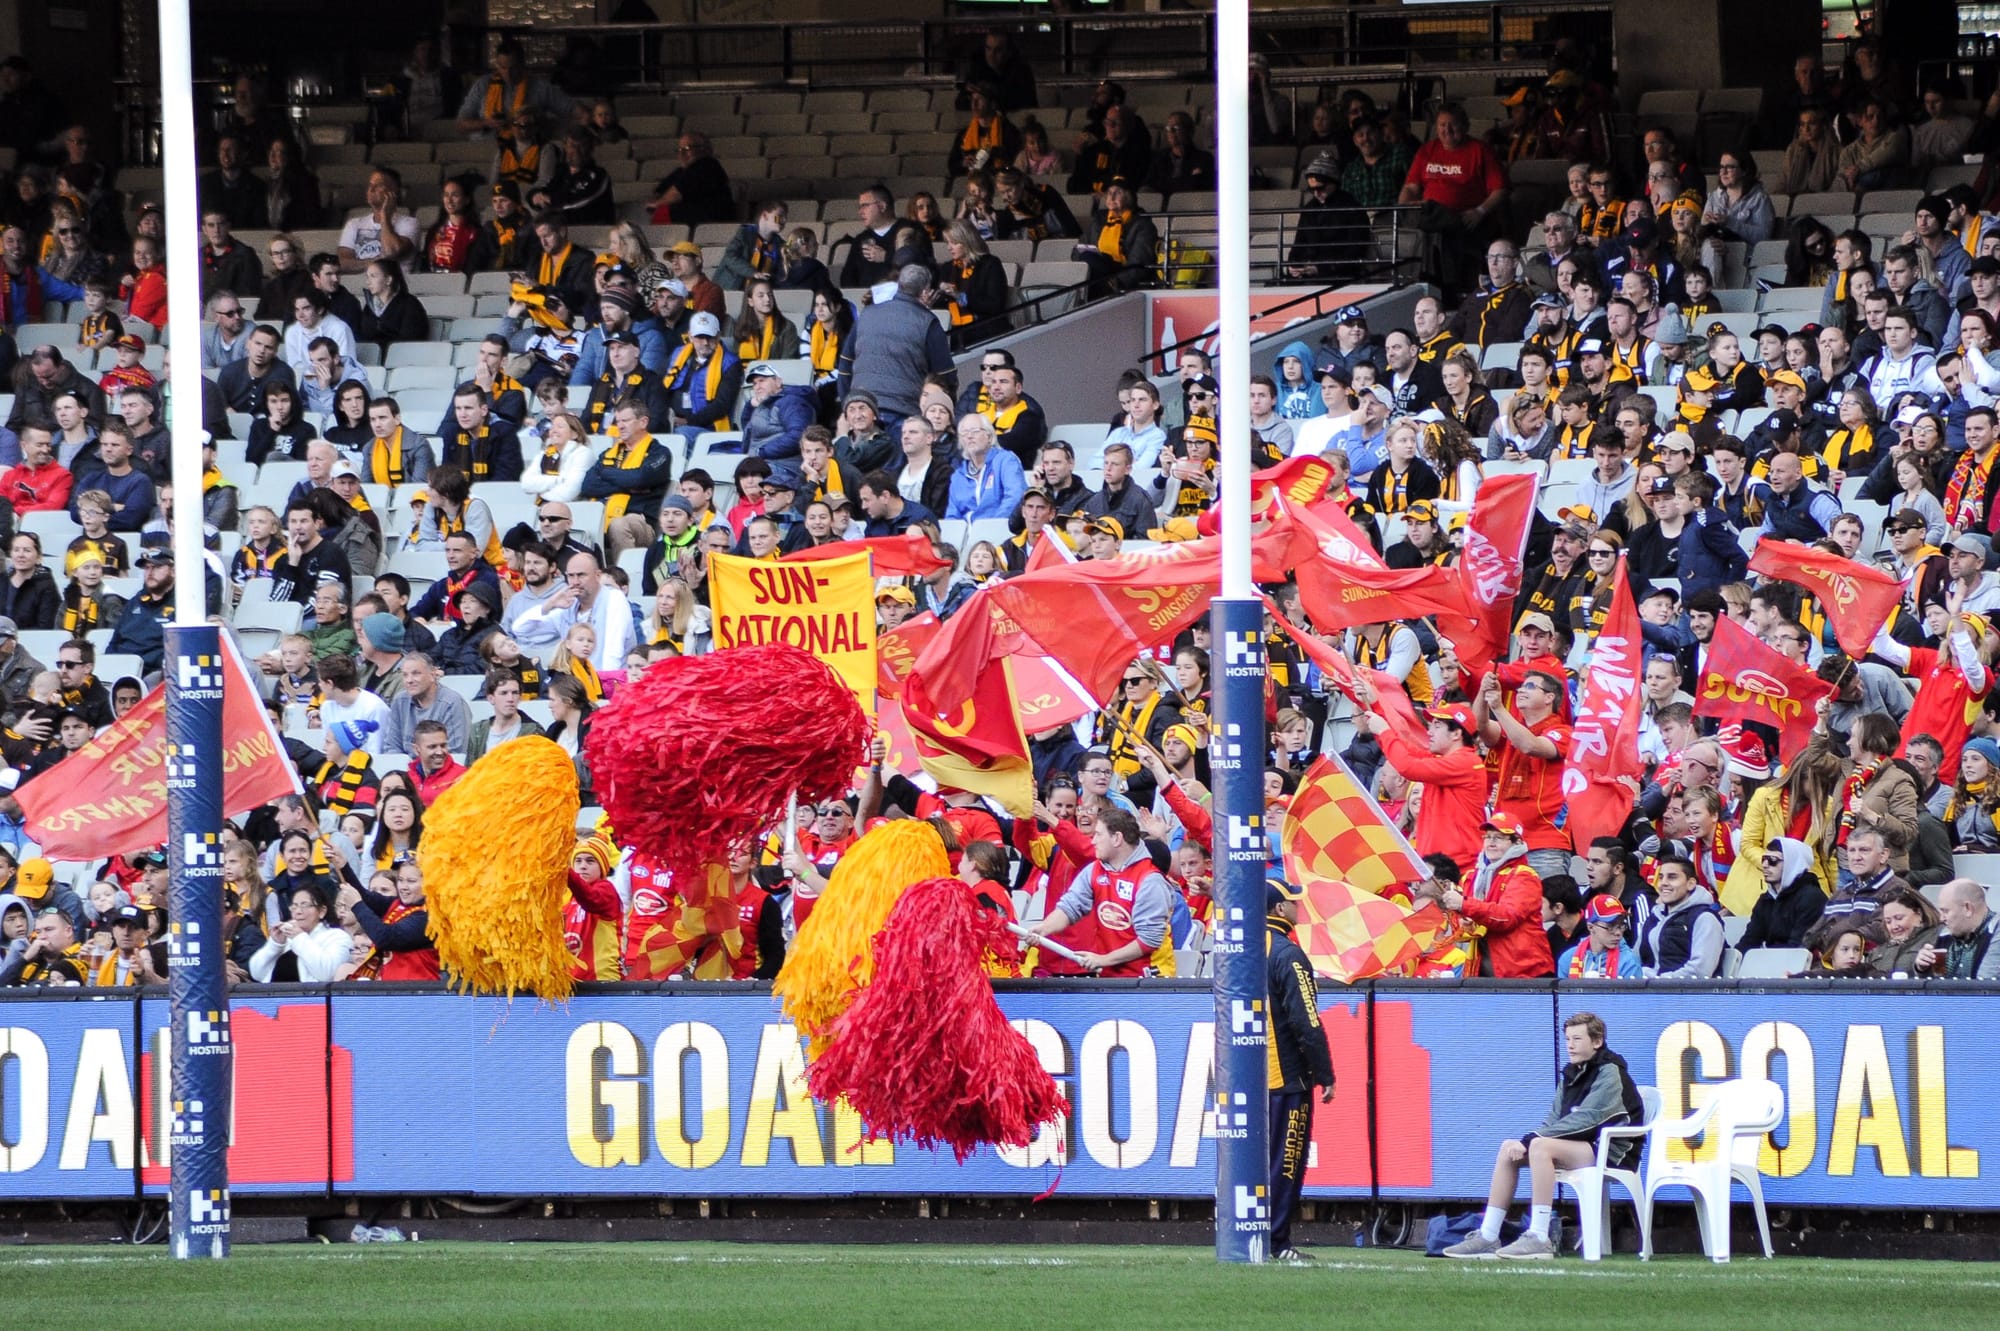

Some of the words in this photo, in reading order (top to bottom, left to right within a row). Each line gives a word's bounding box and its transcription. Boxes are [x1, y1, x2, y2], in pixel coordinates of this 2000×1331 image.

[749, 566, 829, 605] SUN-
[720, 611, 869, 654] SATIONAL
[1655, 1020, 1980, 1178] GOAL
[1282, 1109, 1299, 1180] SECURITY
